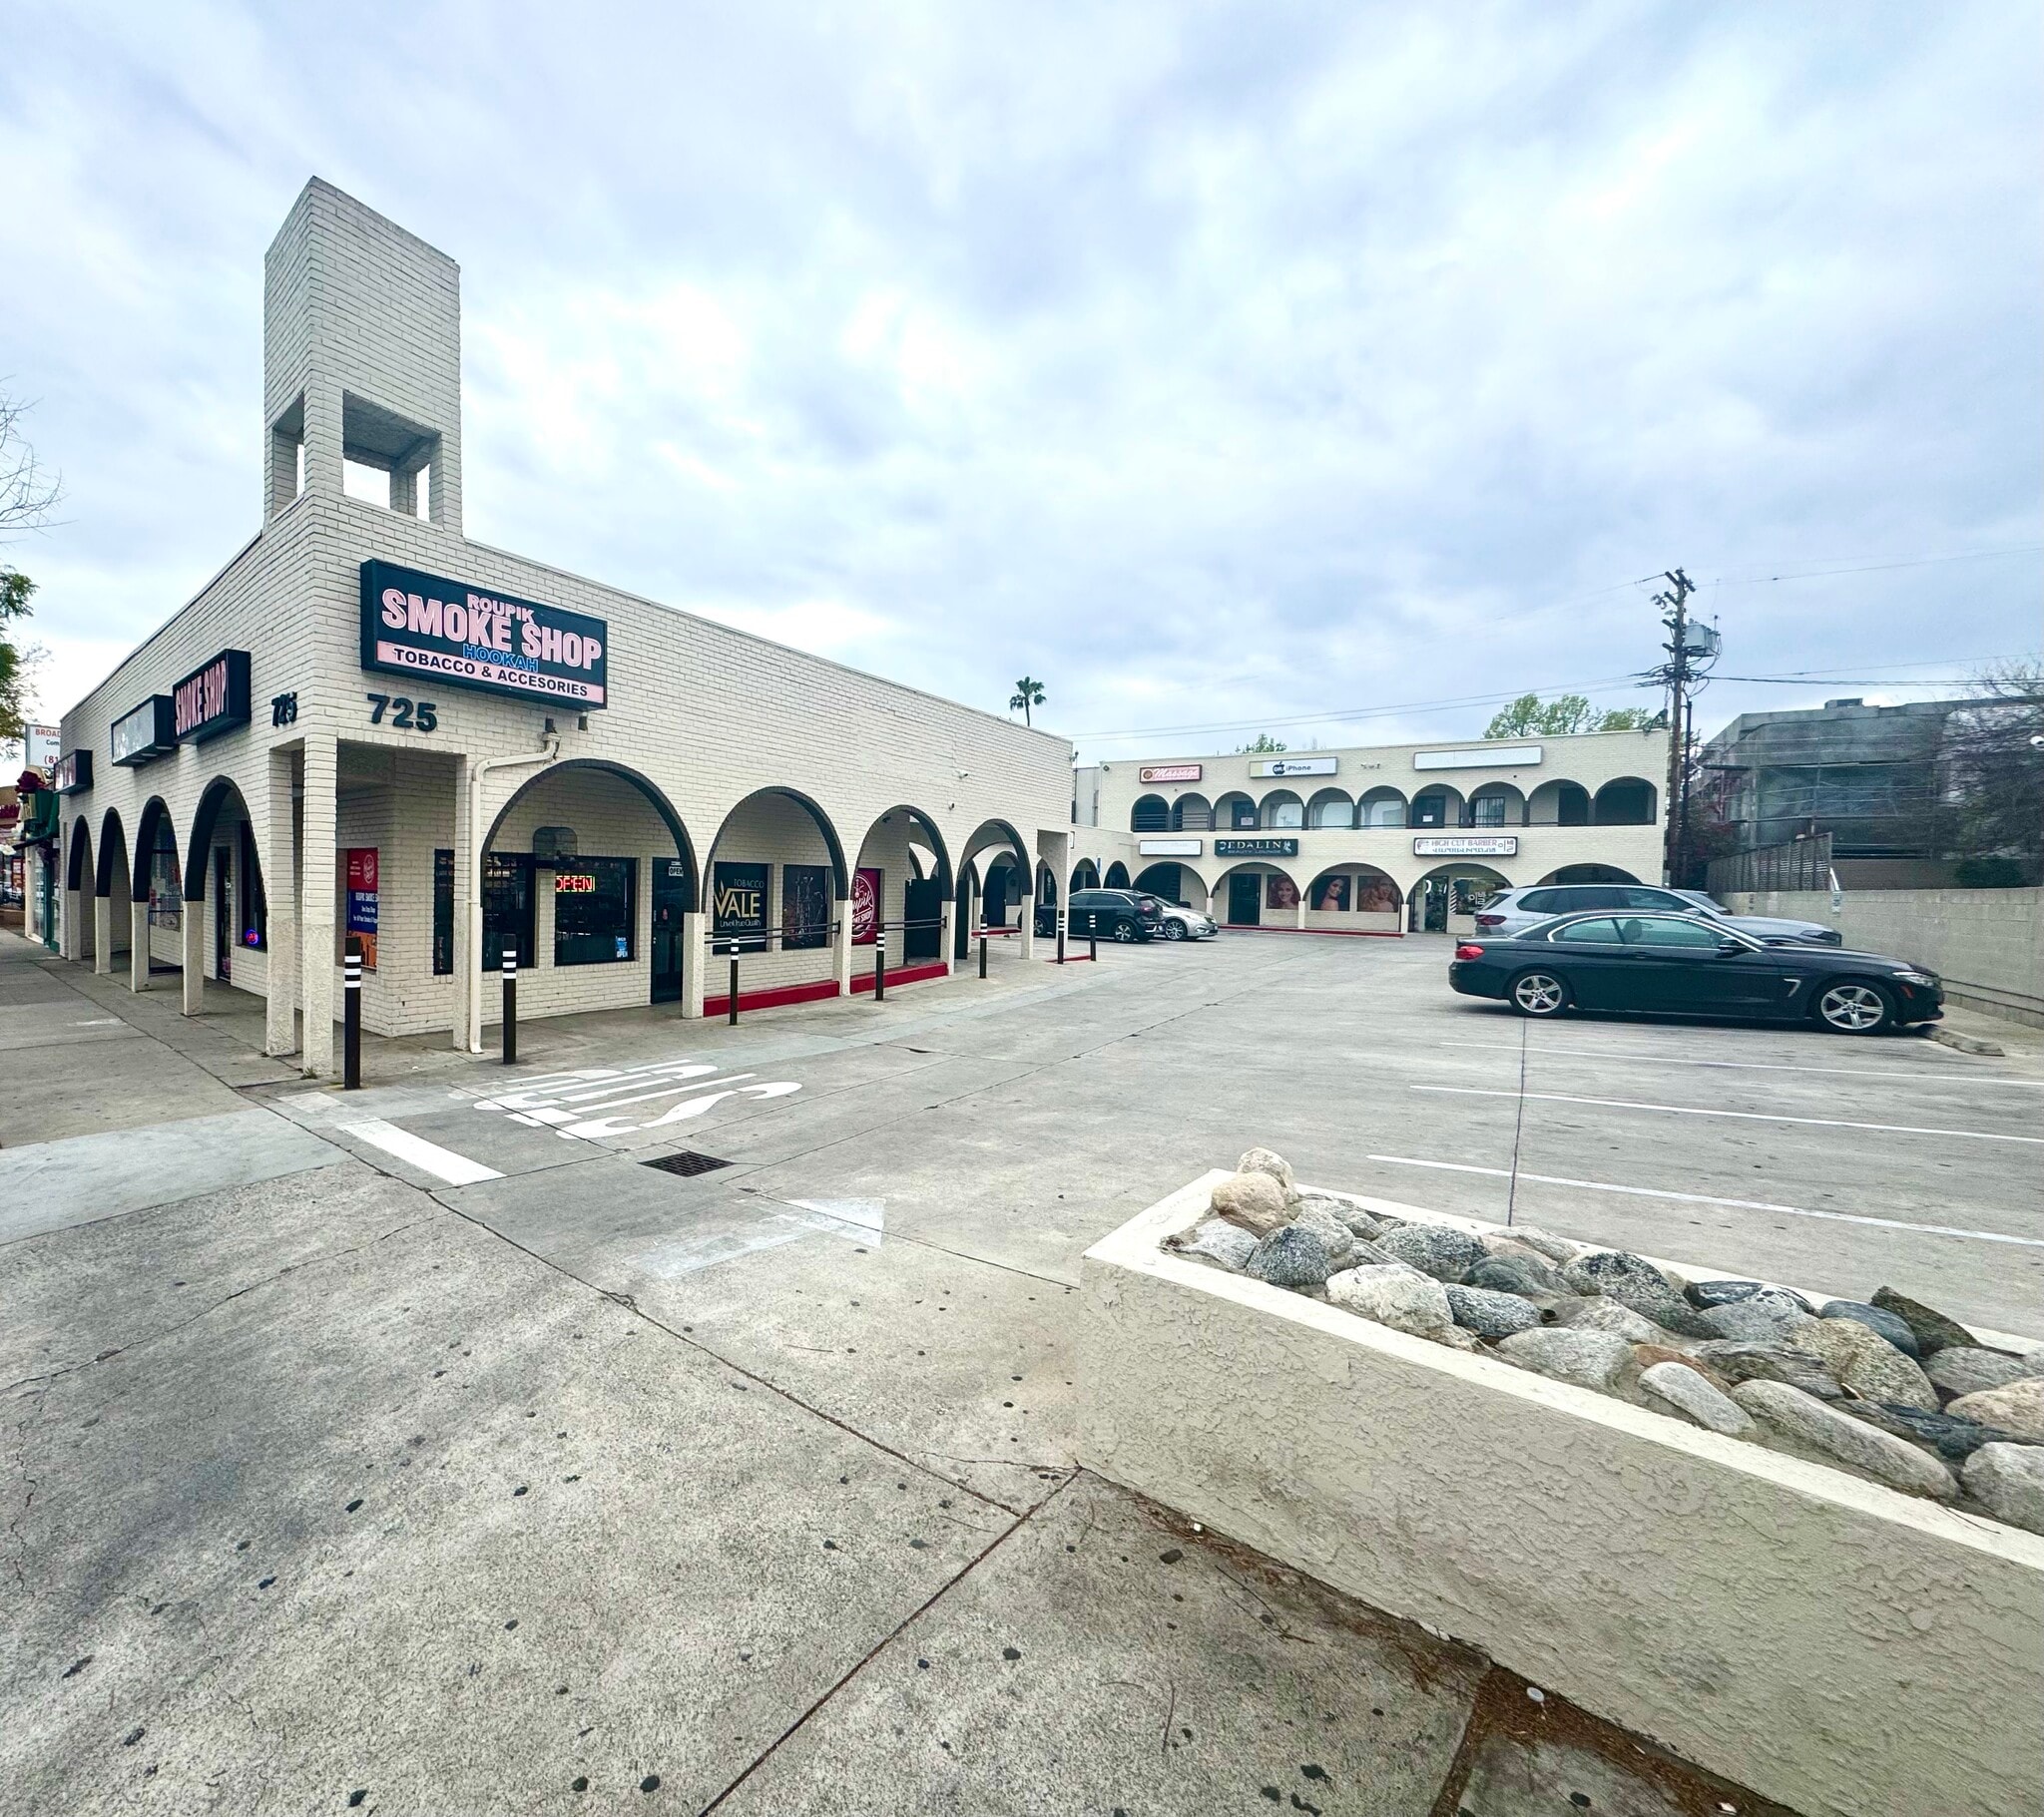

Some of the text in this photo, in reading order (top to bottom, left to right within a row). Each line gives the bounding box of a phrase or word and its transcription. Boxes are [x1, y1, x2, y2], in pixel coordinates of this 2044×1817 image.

[466, 593, 535, 624] ROUPIK
[381, 588, 602, 671] SMOKE SHOP
[393, 648, 588, 696] TOBACCO & ACCESORIES
[462, 644, 539, 674] HOOKAH
[175, 660, 227, 736] SMOKE SHOP
[270, 691, 297, 727] 725
[367, 692, 437, 731] 725
[556, 877, 593, 890] OPEN
[734, 879, 765, 888] TOBACCO
[714, 888, 761, 918] VALE
